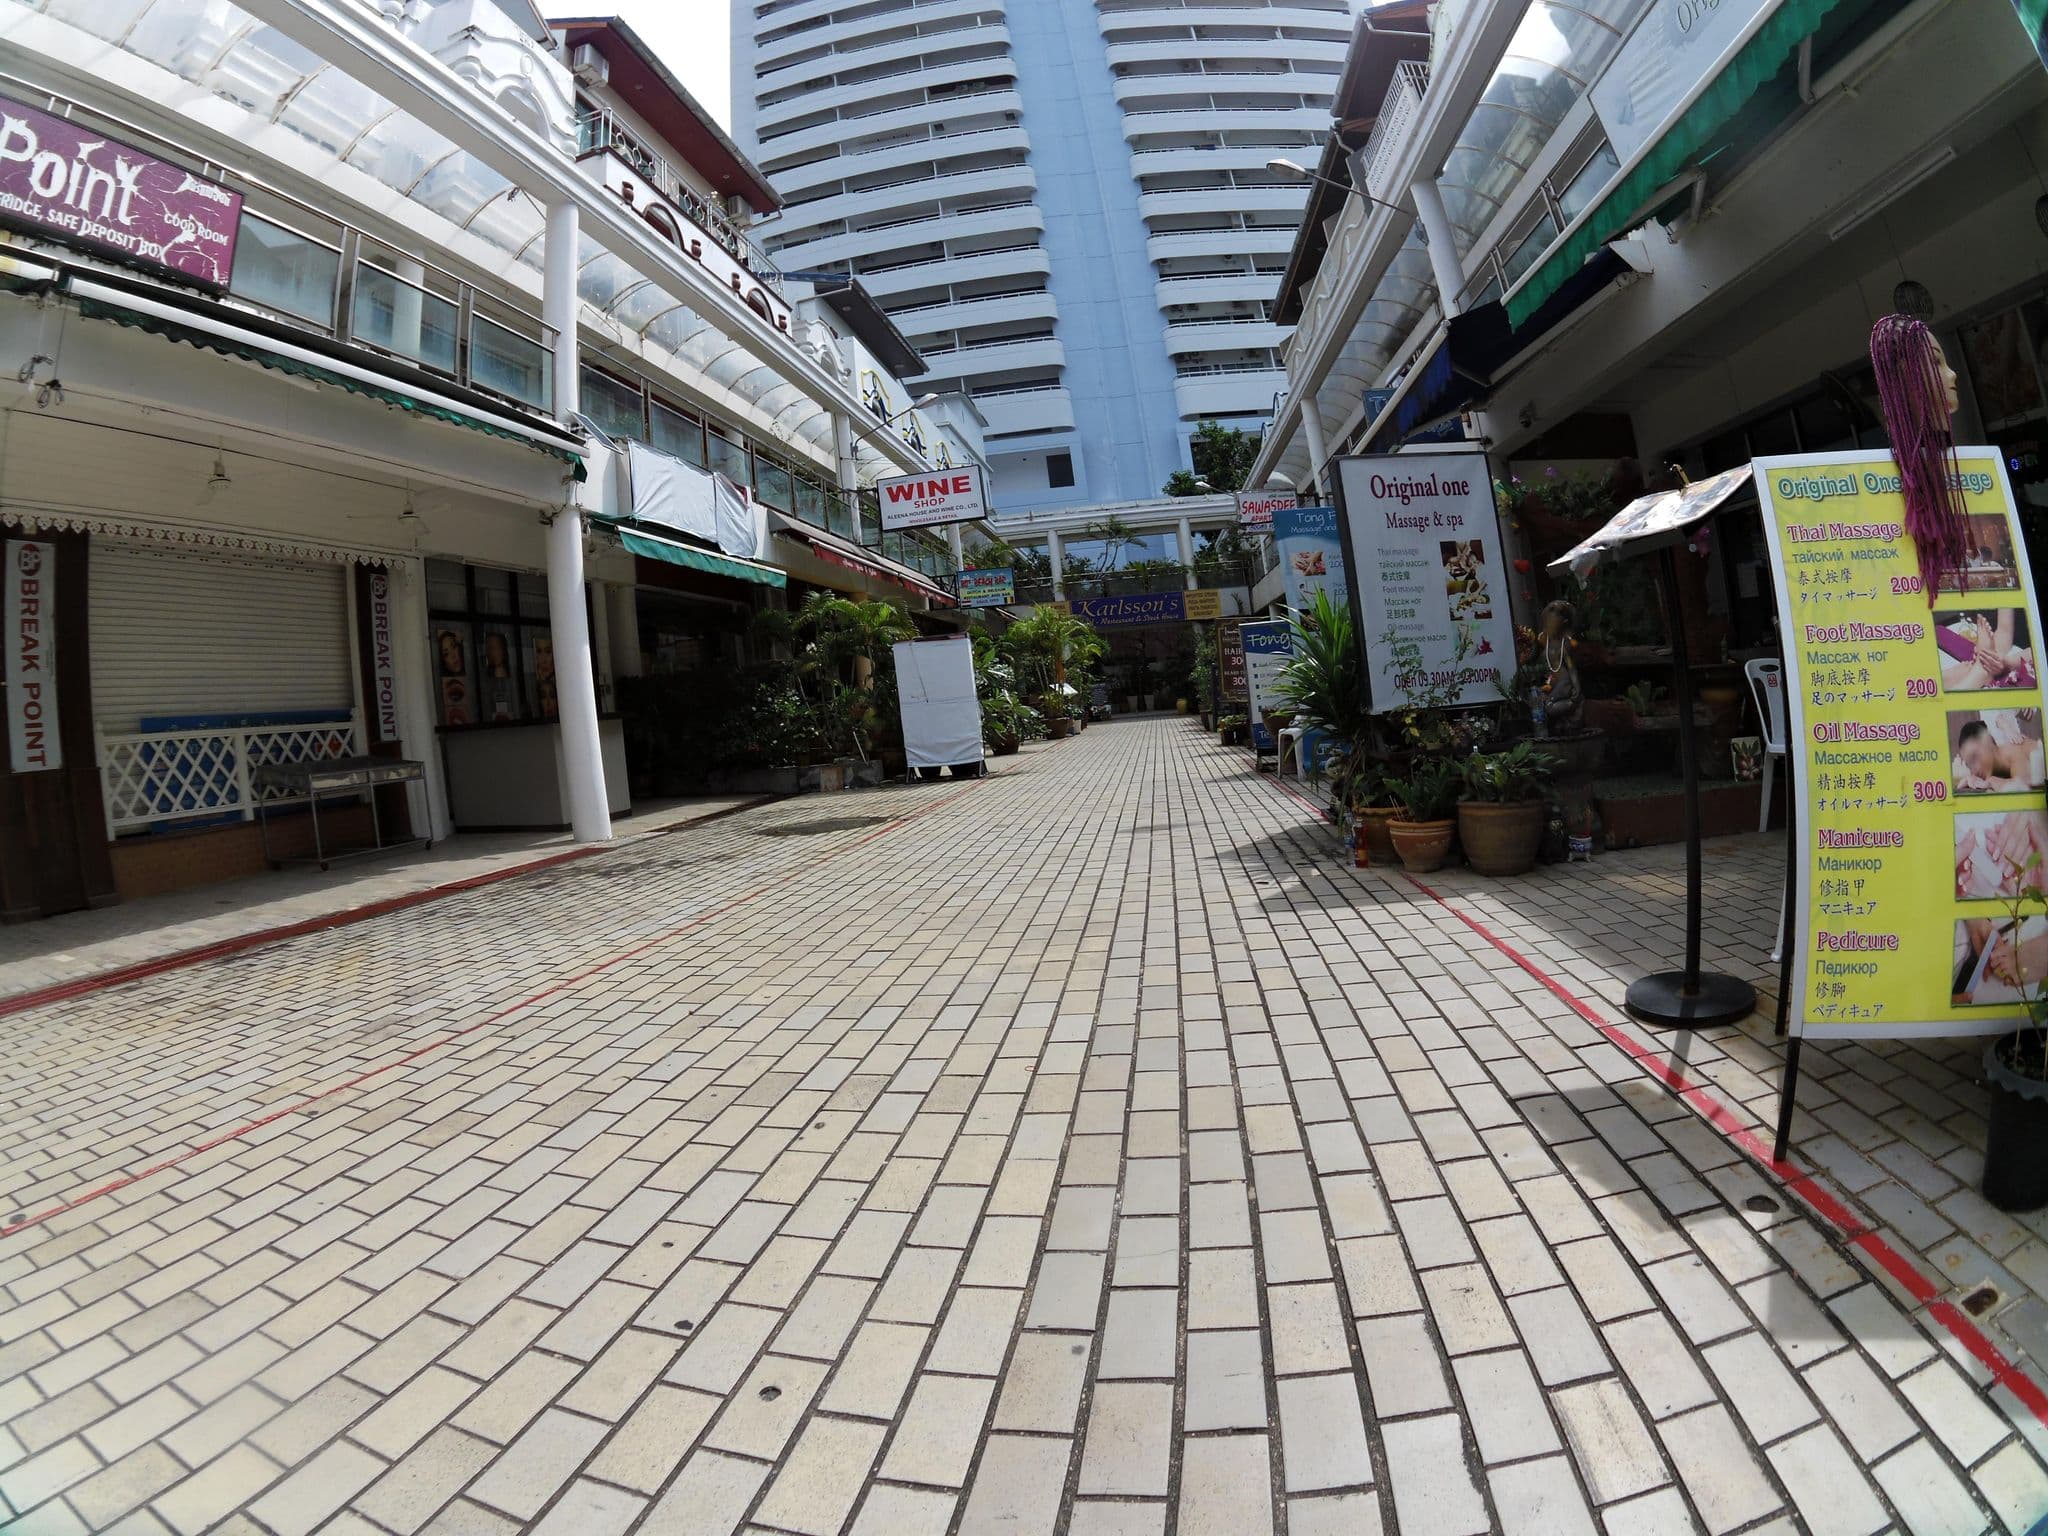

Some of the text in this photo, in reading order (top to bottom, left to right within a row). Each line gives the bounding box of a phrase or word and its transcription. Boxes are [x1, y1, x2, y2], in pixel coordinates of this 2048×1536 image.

[0, 112, 157, 226] Point
[47, 209, 79, 230] SAFE
[77, 216, 136, 250] DEPOSIT
[136, 237, 167, 261] BOX
[886, 475, 972, 503] WINE
[1370, 473, 1470, 505] Original one
[1778, 474, 1858, 501] Original
[1864, 473, 1902, 494] One
[914, 497, 945, 509] SHOP
[1296, 511, 1336, 526] Tong F
[1386, 512, 1464, 532] Massage & spa
[1290, 526, 1321, 535] Massage
[1787, 522, 1902, 543] Thai Massage
[1792, 548, 1899, 564] тайский массаж
[1799, 568, 1853, 586] 泰式按摩
[1890, 576, 1921, 594] 200
[1801, 587, 1878, 603] タイマッサージ
[1078, 594, 1178, 617] Karlsson's
[1805, 622, 1924, 643] Foot Massage
[1231, 656, 1243, 666] 30
[1807, 650, 1889, 665] Массаж ног
[20, 578, 47, 767] BREAK POINT
[375, 602, 396, 737] BREAK POINT
[1811, 668, 1870, 687] 脚底按摩
[1812, 688, 1896, 705] 足のマッサージ
[1906, 678, 1937, 698] 200
[1813, 721, 1920, 743] Oil Massage
[1815, 748, 1938, 765] Массажное масло
[1817, 772, 1876, 790] 精油按摩
[1913, 780, 1946, 802] 300
[1818, 794, 1908, 811] オイルマッサージ
[1818, 828, 1904, 849] Manicure
[1818, 856, 1882, 873] Маникюр
[1819, 879, 1866, 897] 修指甲
[1819, 901, 1877, 916] マニキュア
[1817, 931, 1899, 951] Pedicure
[1815, 959, 1878, 977] Педикюр
[1816, 982, 1846, 999] 修脚
